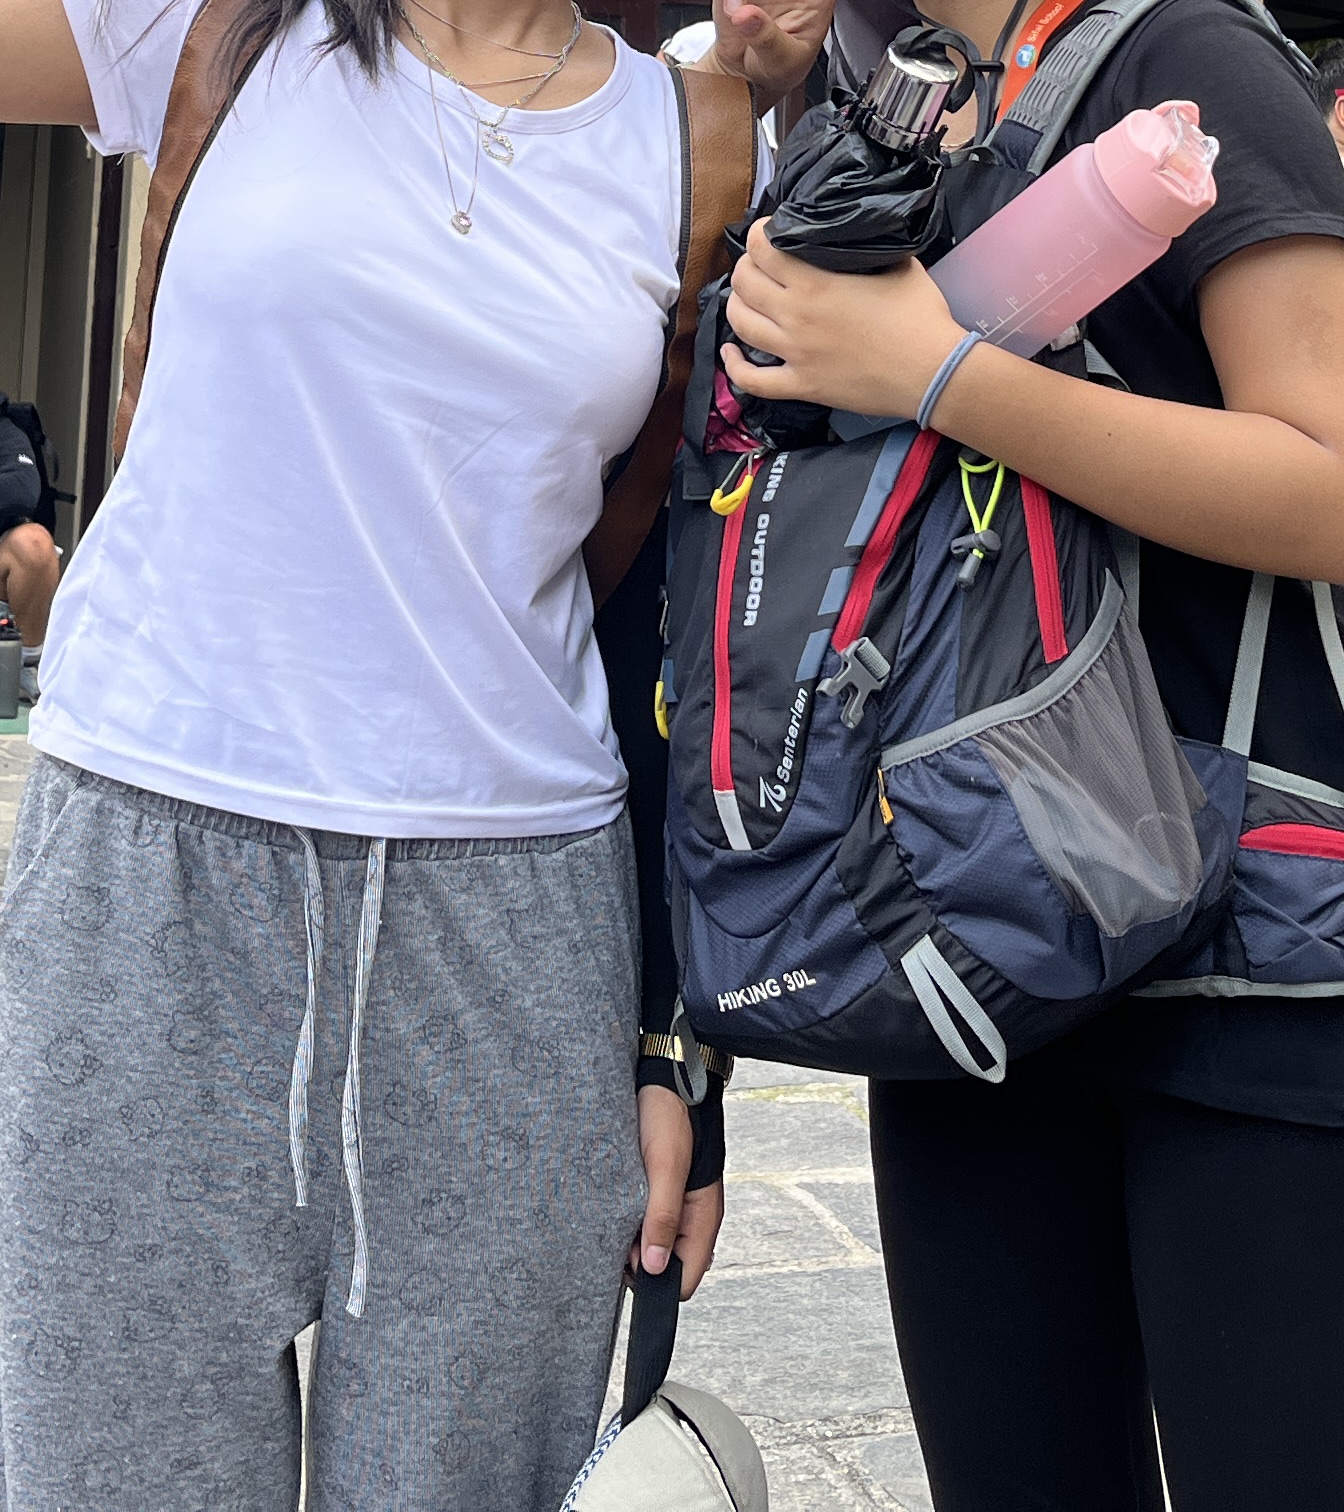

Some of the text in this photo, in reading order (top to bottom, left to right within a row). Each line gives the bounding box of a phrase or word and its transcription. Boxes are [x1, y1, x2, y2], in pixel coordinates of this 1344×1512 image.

[743, 451, 790, 626] KING OUTDOOR
[717, 969, 817, 1012] HIKING 30L
